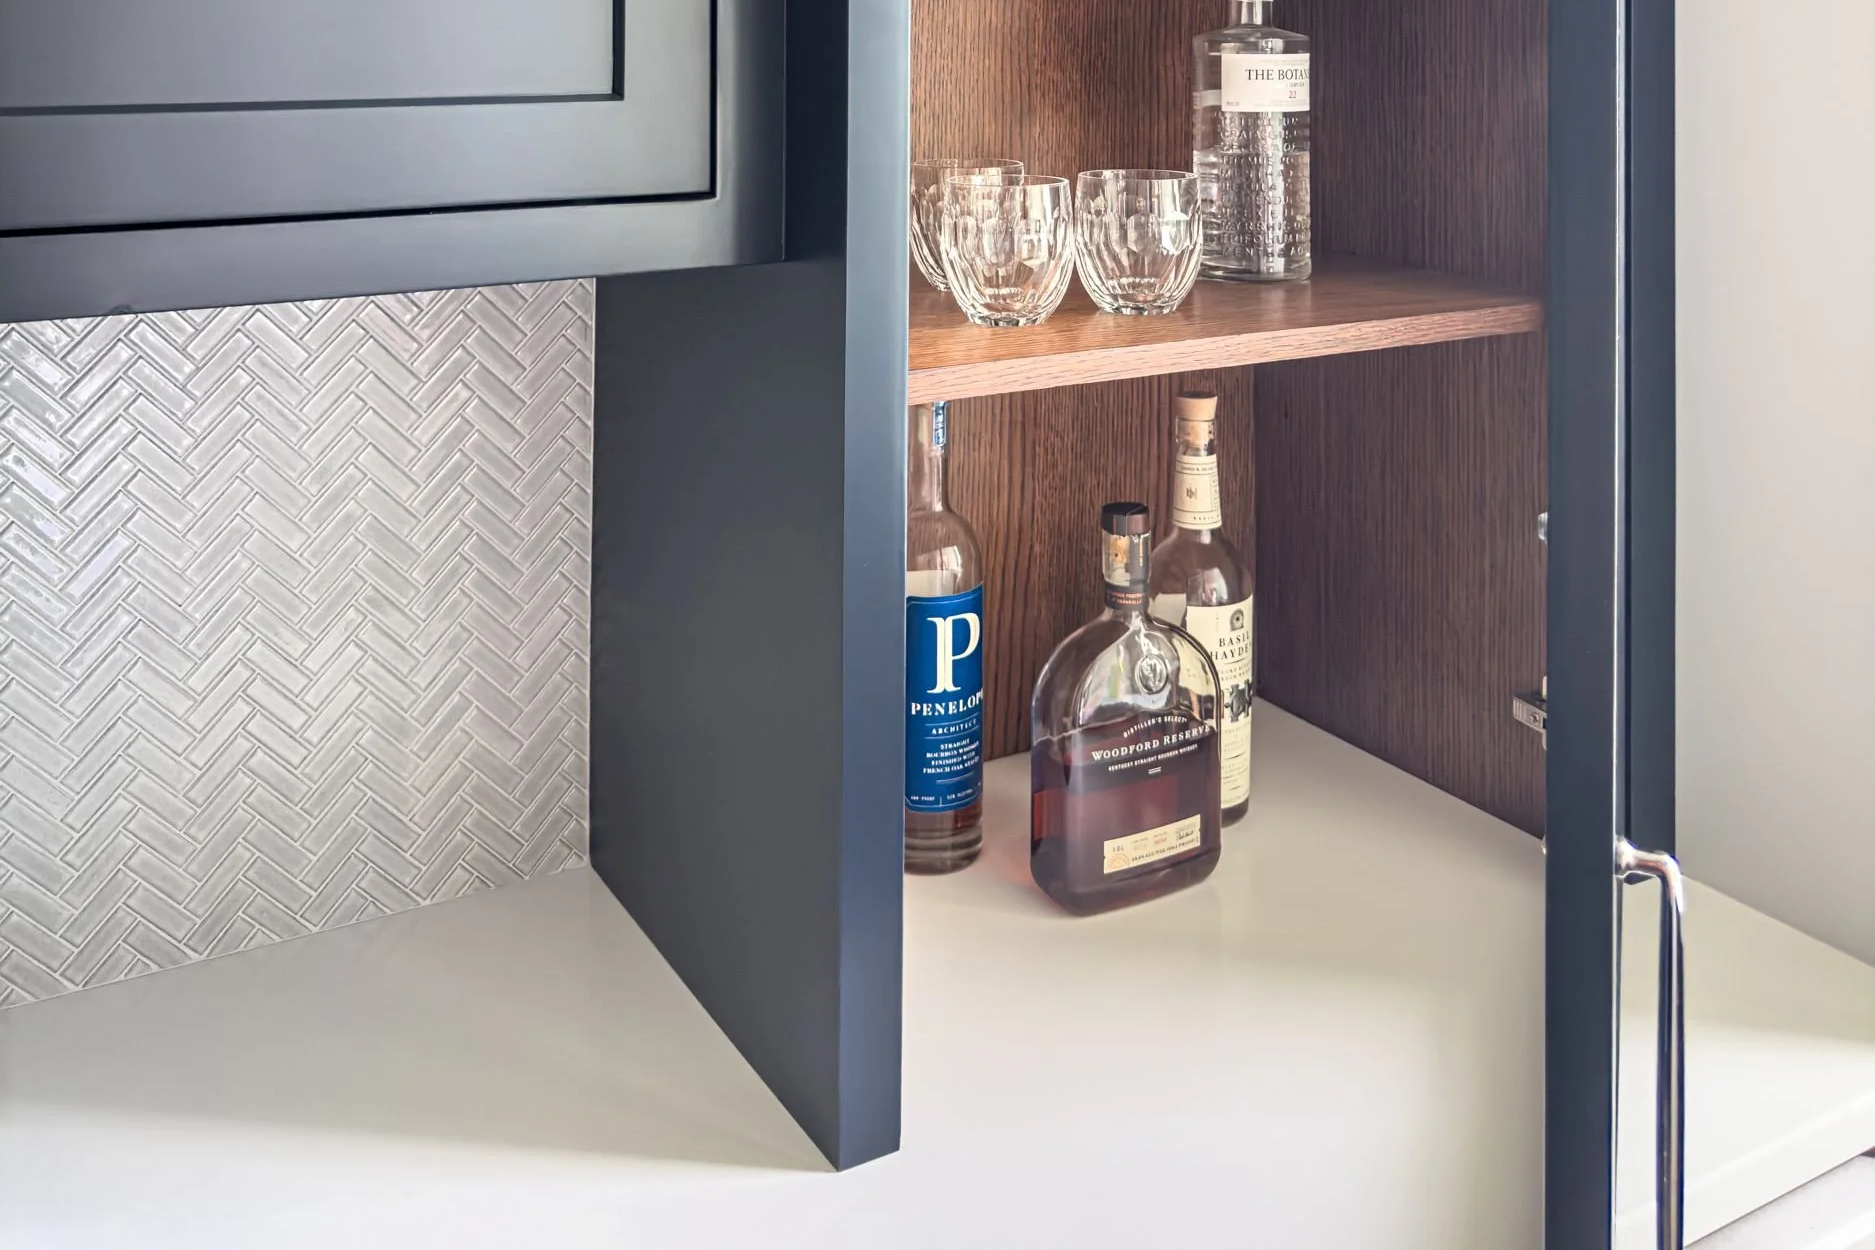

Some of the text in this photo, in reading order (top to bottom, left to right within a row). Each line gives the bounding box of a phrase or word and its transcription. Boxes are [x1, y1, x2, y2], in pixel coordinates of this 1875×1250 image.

[1244, 68, 1275, 81] THE
[1288, 90, 1297, 99] 22
[1218, 630, 1250, 648] BASIL
[926, 612, 980, 693] P
[931, 718, 977, 735] ARCHITECT
[940, 737, 970, 751] STRAIGHT
[1091, 738, 1160, 762] WOODFORD
[1163, 723, 1211, 746] RESERVE
[926, 749, 958, 759] BOURBON
[922, 765, 951, 775] FRENCH
[950, 763, 964, 773] OAK
